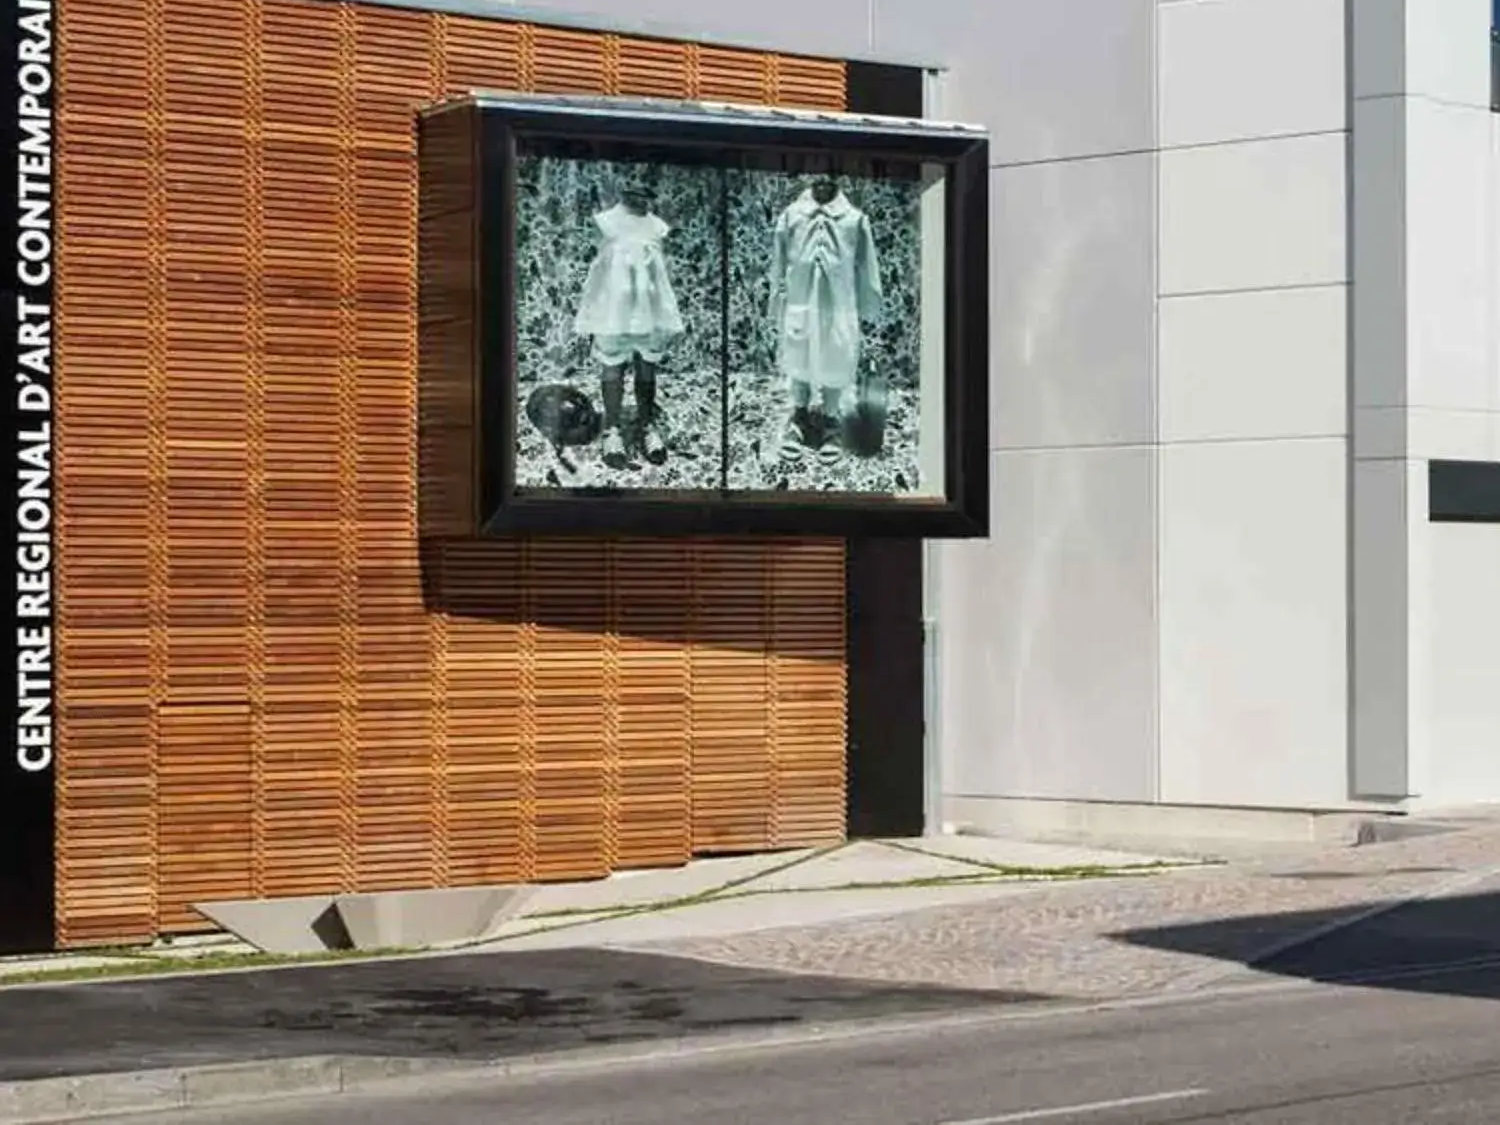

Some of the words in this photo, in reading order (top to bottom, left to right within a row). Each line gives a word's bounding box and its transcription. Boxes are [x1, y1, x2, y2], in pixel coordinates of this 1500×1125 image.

[16, 297, 51, 411] D'ART
[17, 422, 51, 617] REGIONAL
[17, 624, 51, 772] CENTRE
